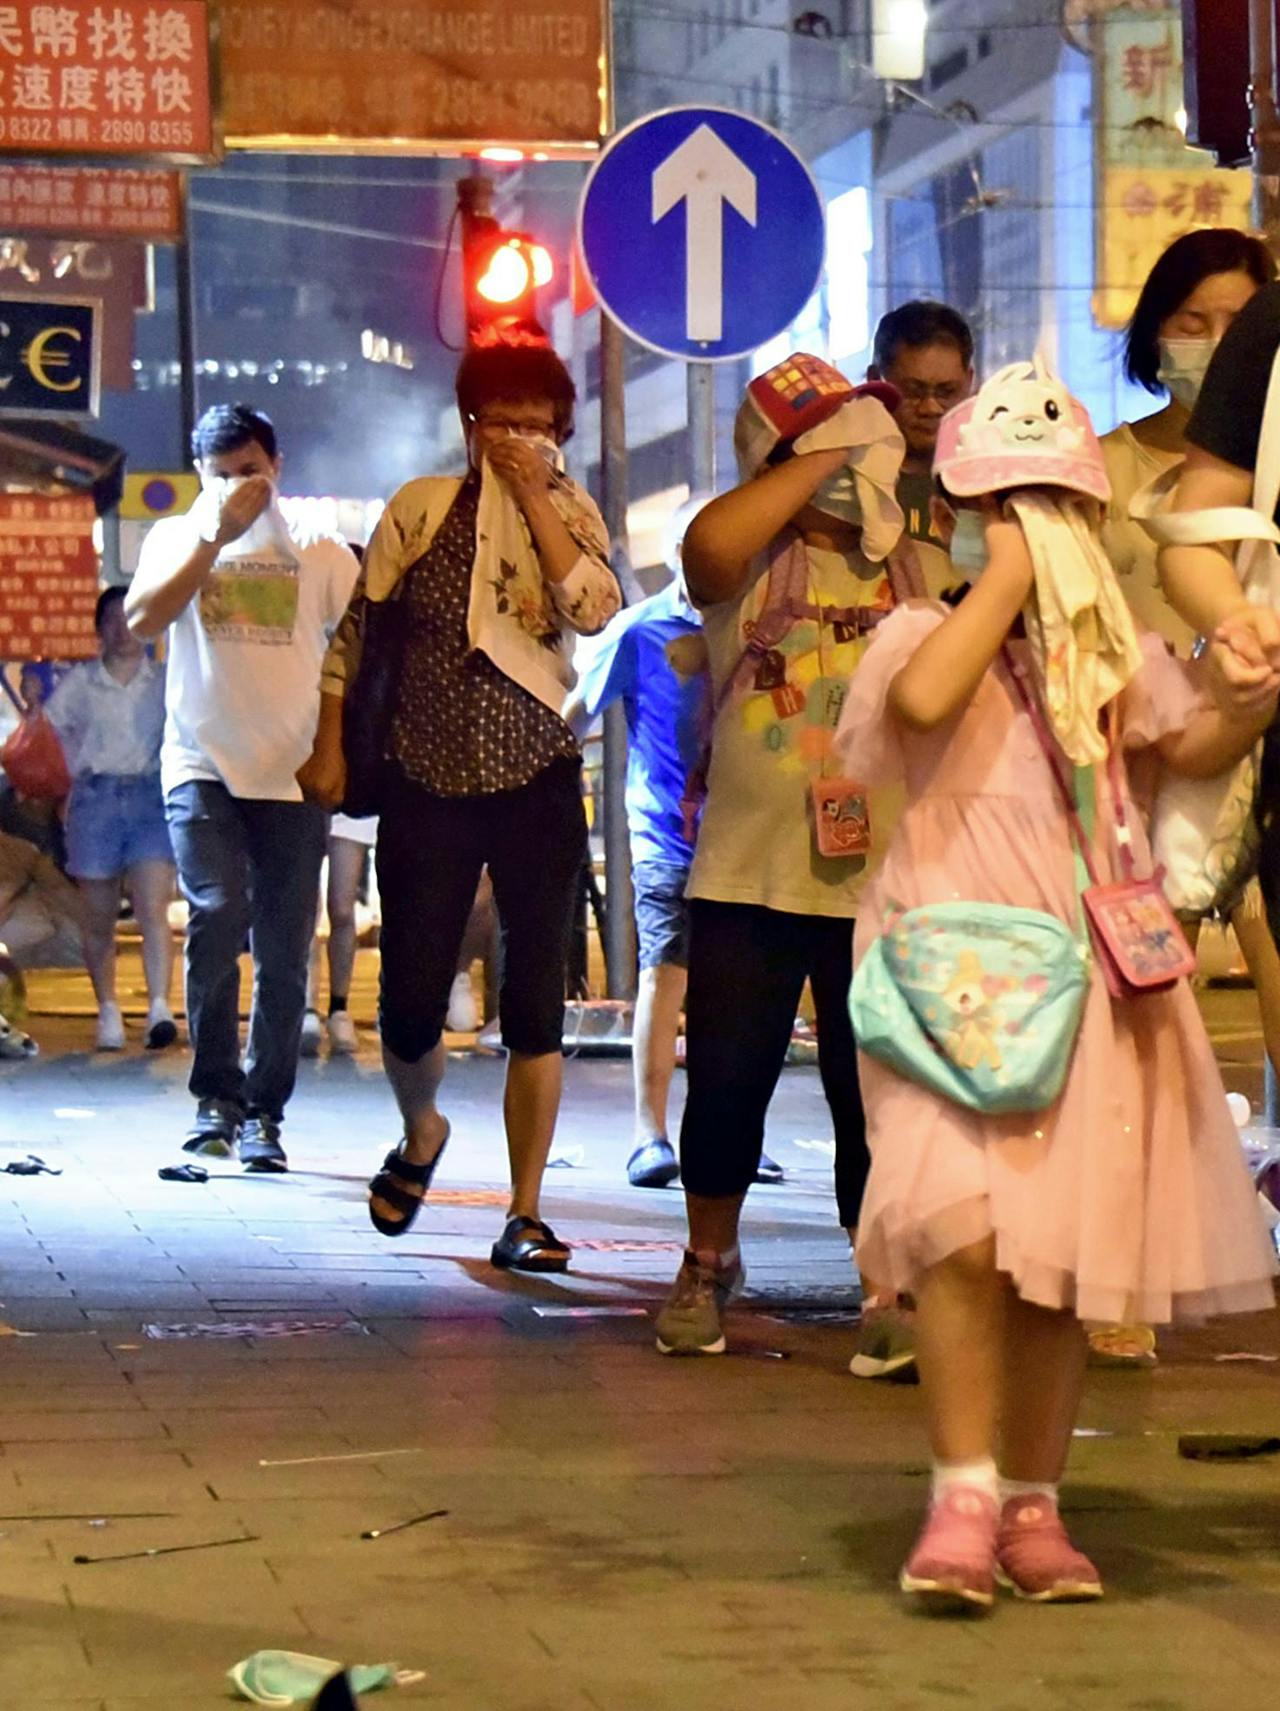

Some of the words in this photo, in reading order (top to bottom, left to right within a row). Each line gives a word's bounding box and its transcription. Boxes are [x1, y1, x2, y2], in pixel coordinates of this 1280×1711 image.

[370, 10, 496, 55] EXCHANGE
[501, 14, 587, 57] LIMITED
[10, 117, 51, 141] 8322
[101, 120, 145, 143] 2890
[150, 121, 193, 146] 8355
